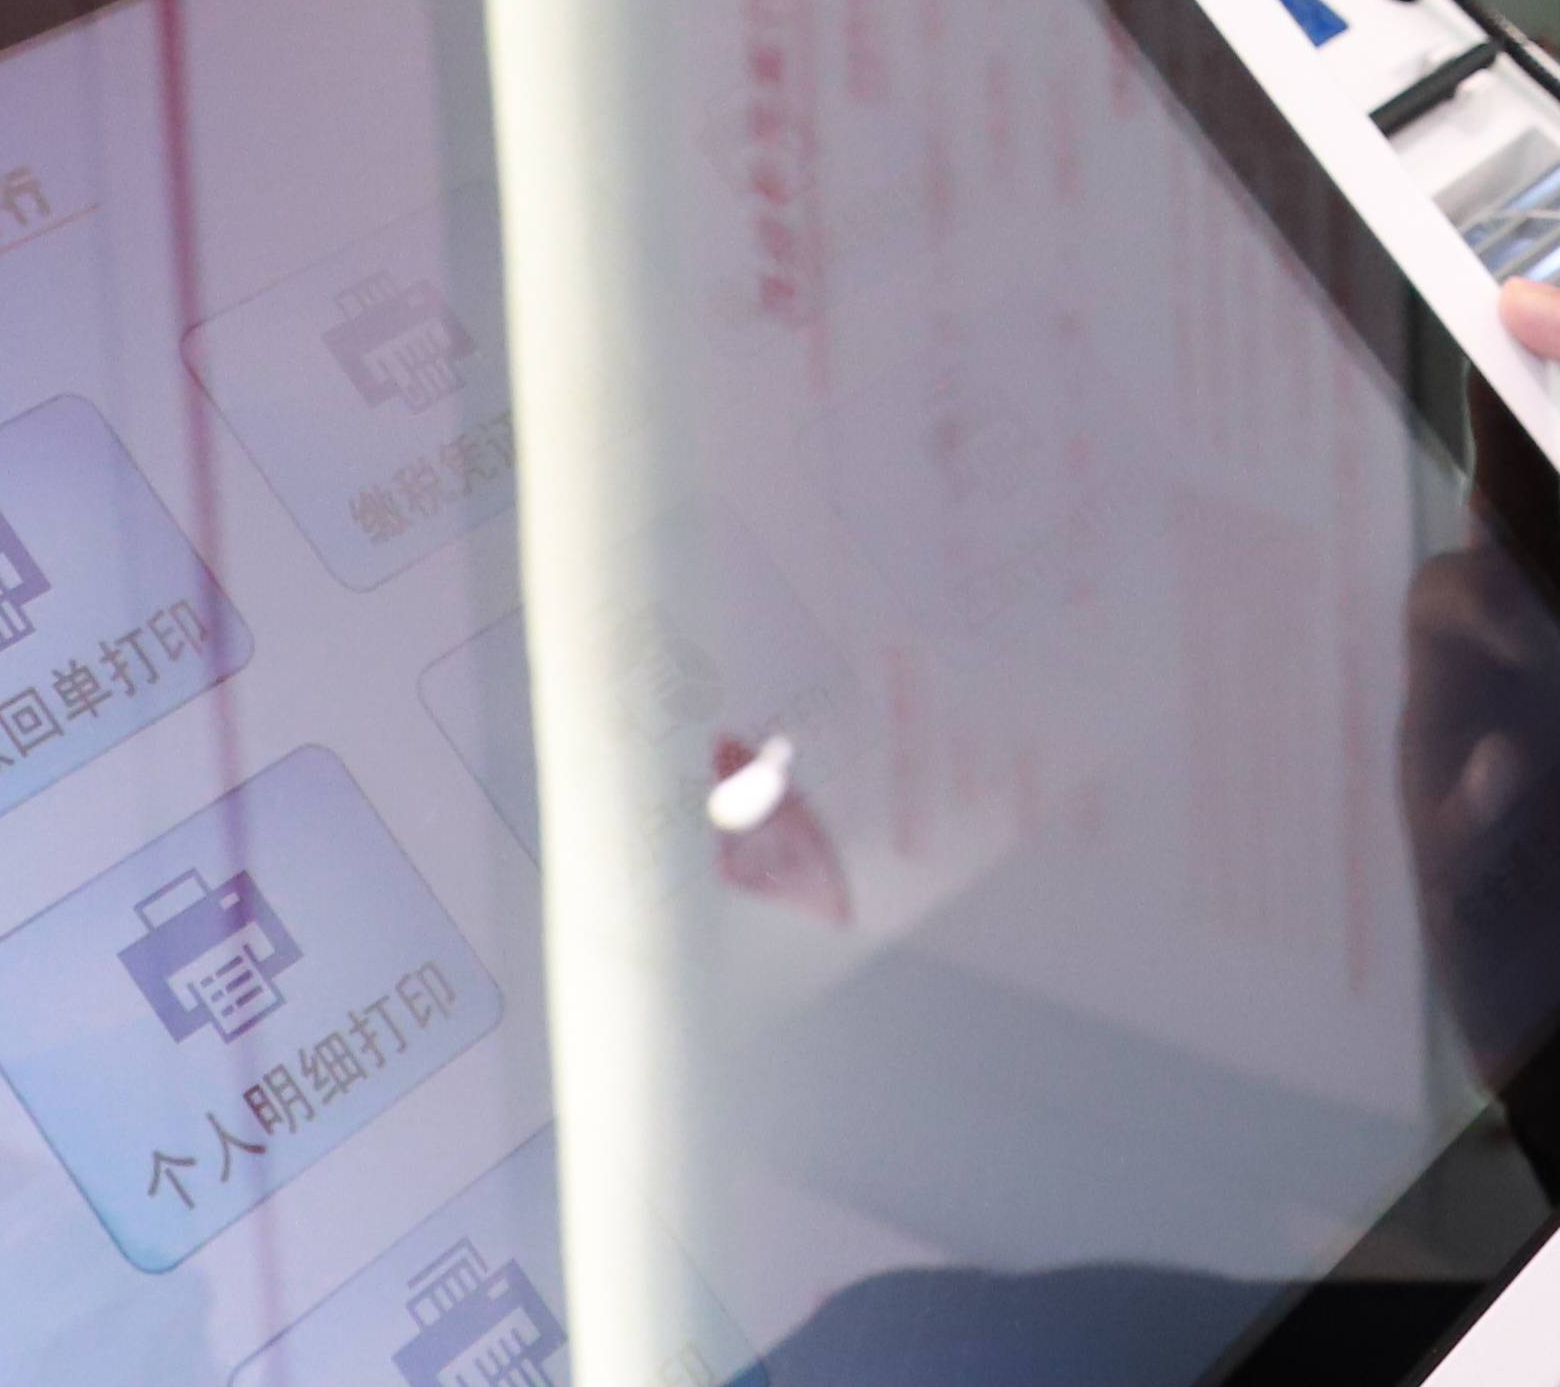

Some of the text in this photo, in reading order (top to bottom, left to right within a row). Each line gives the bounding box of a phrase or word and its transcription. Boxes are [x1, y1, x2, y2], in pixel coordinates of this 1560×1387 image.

[146, 957, 460, 1212] 个人明细打印
